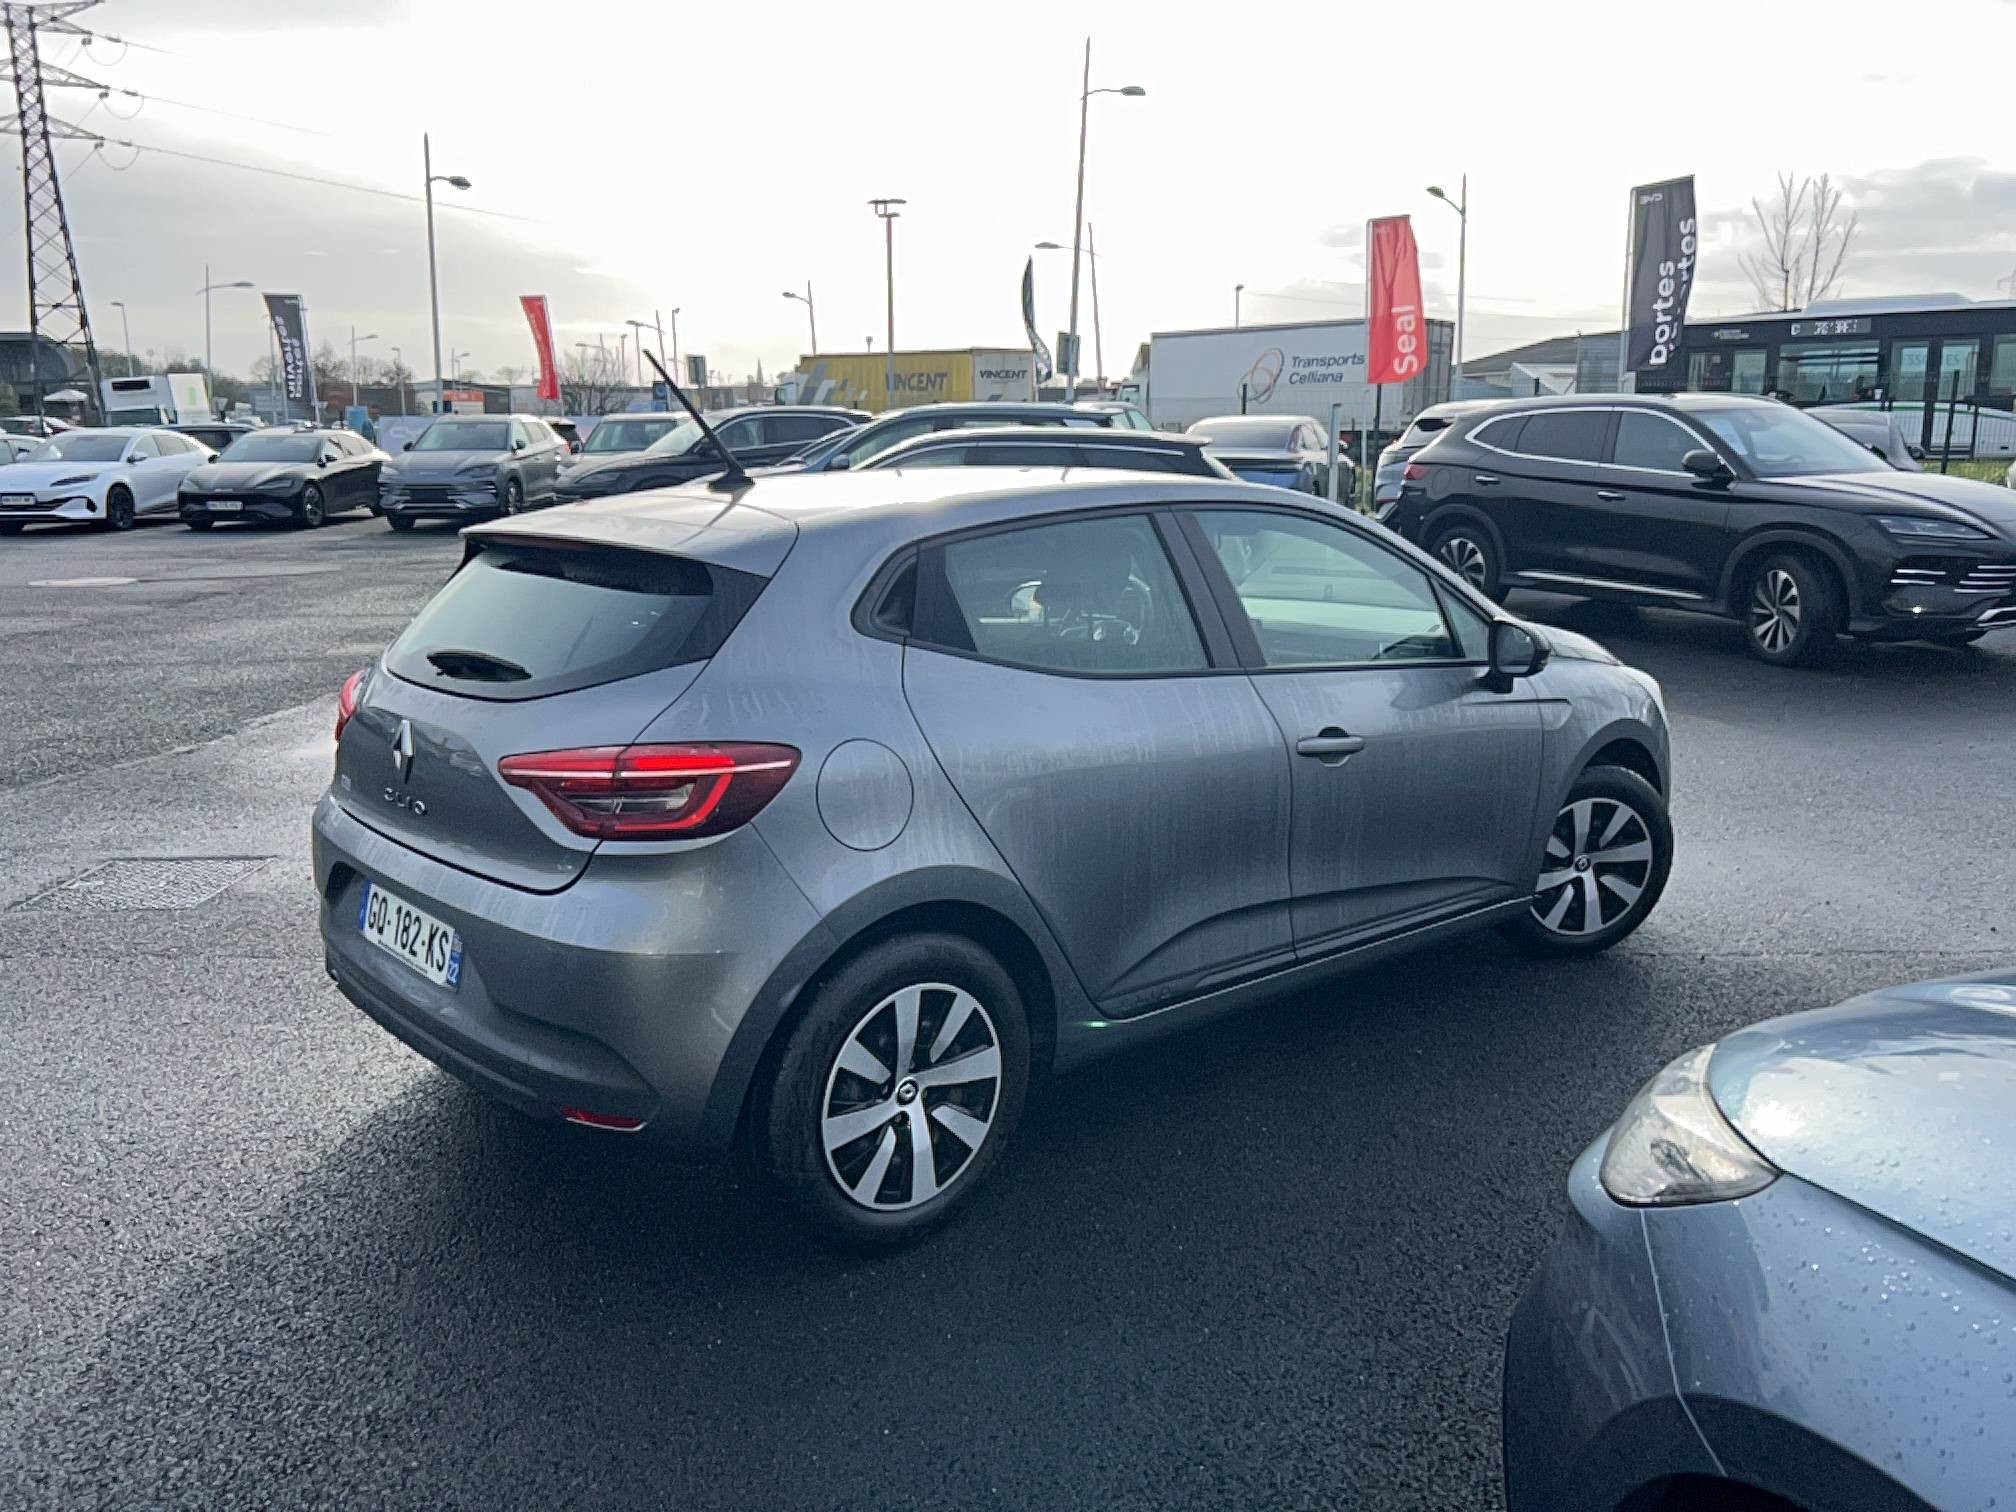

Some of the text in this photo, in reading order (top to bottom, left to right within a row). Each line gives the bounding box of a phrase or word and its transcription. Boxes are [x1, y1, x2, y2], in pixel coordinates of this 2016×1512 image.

[1649, 260, 1676, 366] portes
[1291, 353, 1366, 369] Transports
[1391, 304, 1418, 376] Seal
[979, 369, 1028, 379] VINCENT
[1288, 370, 1344, 385] Celliana
[368, 891, 450, 973] GQ-182-KS
